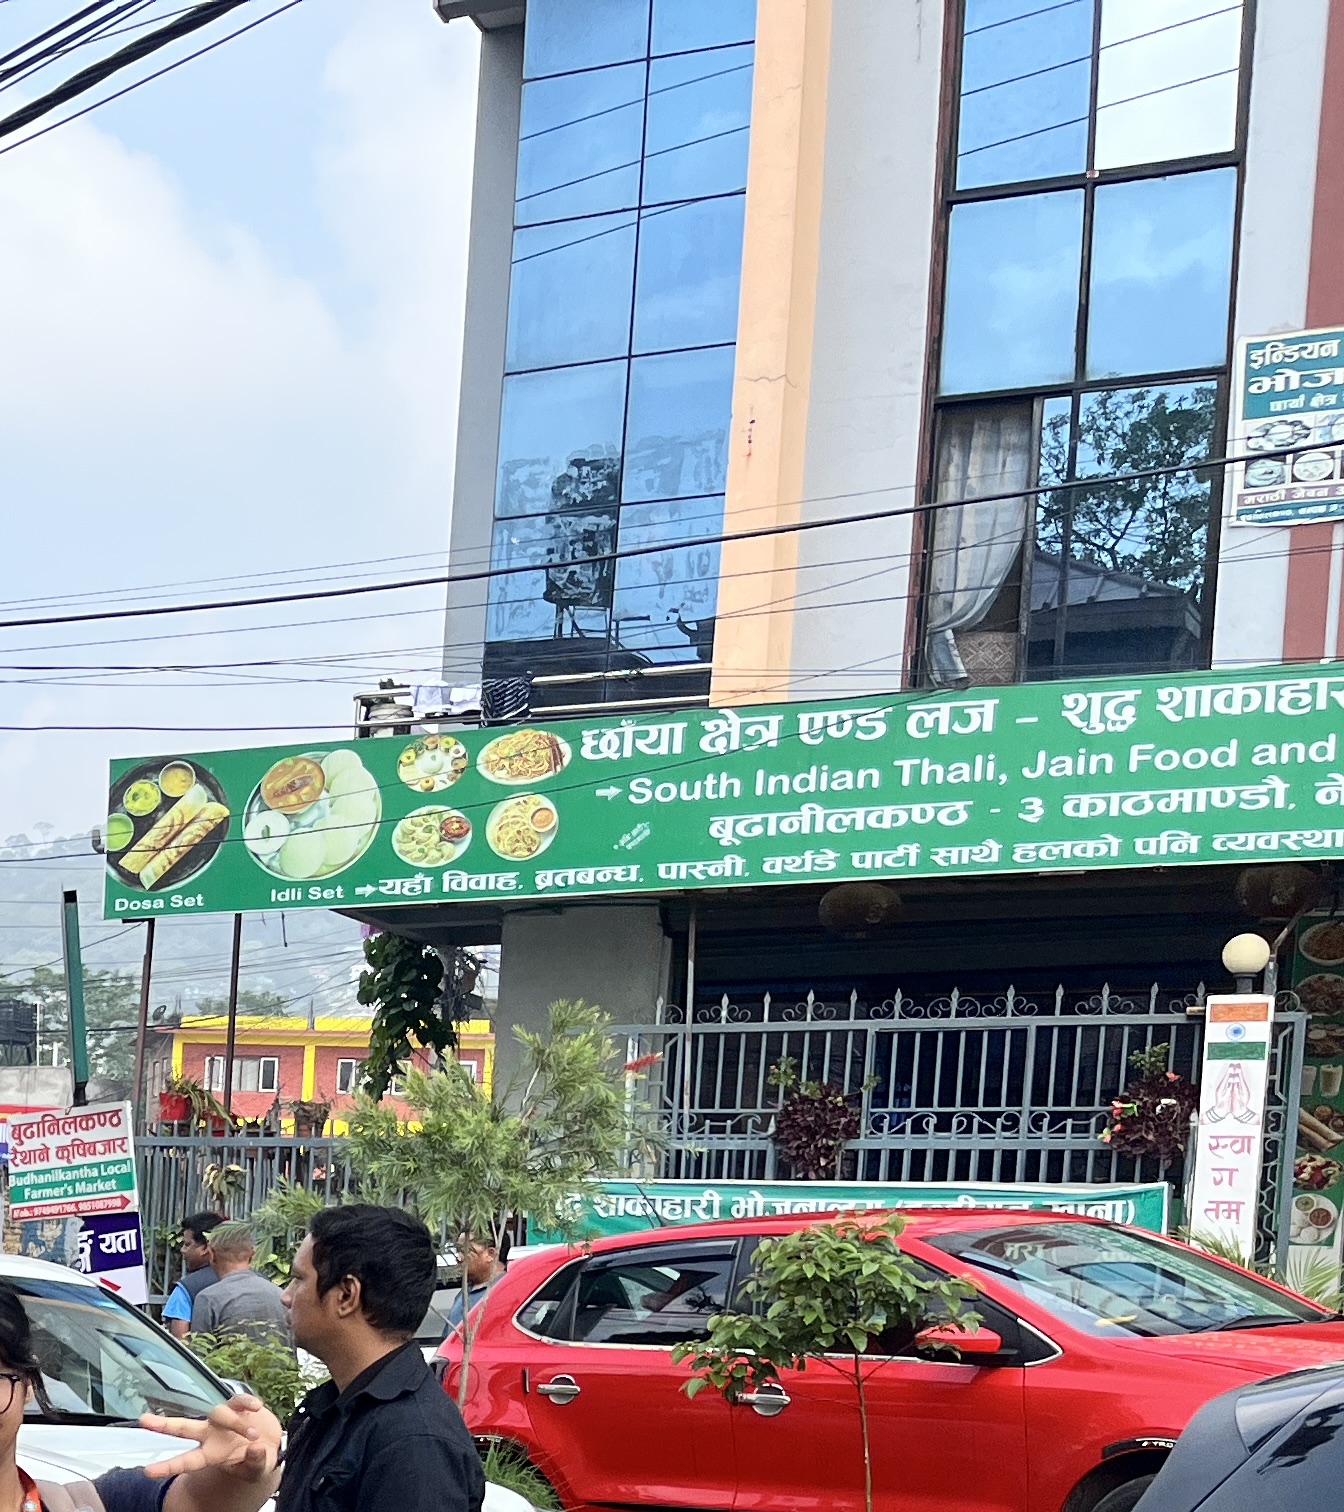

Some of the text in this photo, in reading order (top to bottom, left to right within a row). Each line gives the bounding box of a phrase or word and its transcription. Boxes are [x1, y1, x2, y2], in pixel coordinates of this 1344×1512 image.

[699, 708, 784, 754] क्षेत्र
[796, 706, 893, 746] एण्ड
[905, 699, 1000, 739] लज
[1061, 689, 1143, 735] शुद्ध
[628, 733, 1337, 805] South Indian Thali, Jain Food and
[1017, 797, 1045, 824] ३
[851, 843, 921, 870] पार्टी
[930, 838, 1003, 867] साथै
[1133, 829, 1203, 856] पनि
[115, 894, 205, 912] Dosa Set
[271, 885, 344, 903] Idli Set
[9, 1161, 132, 1187] Budhanilkantha Local
[24, 1178, 117, 1200] Farmer's Market
